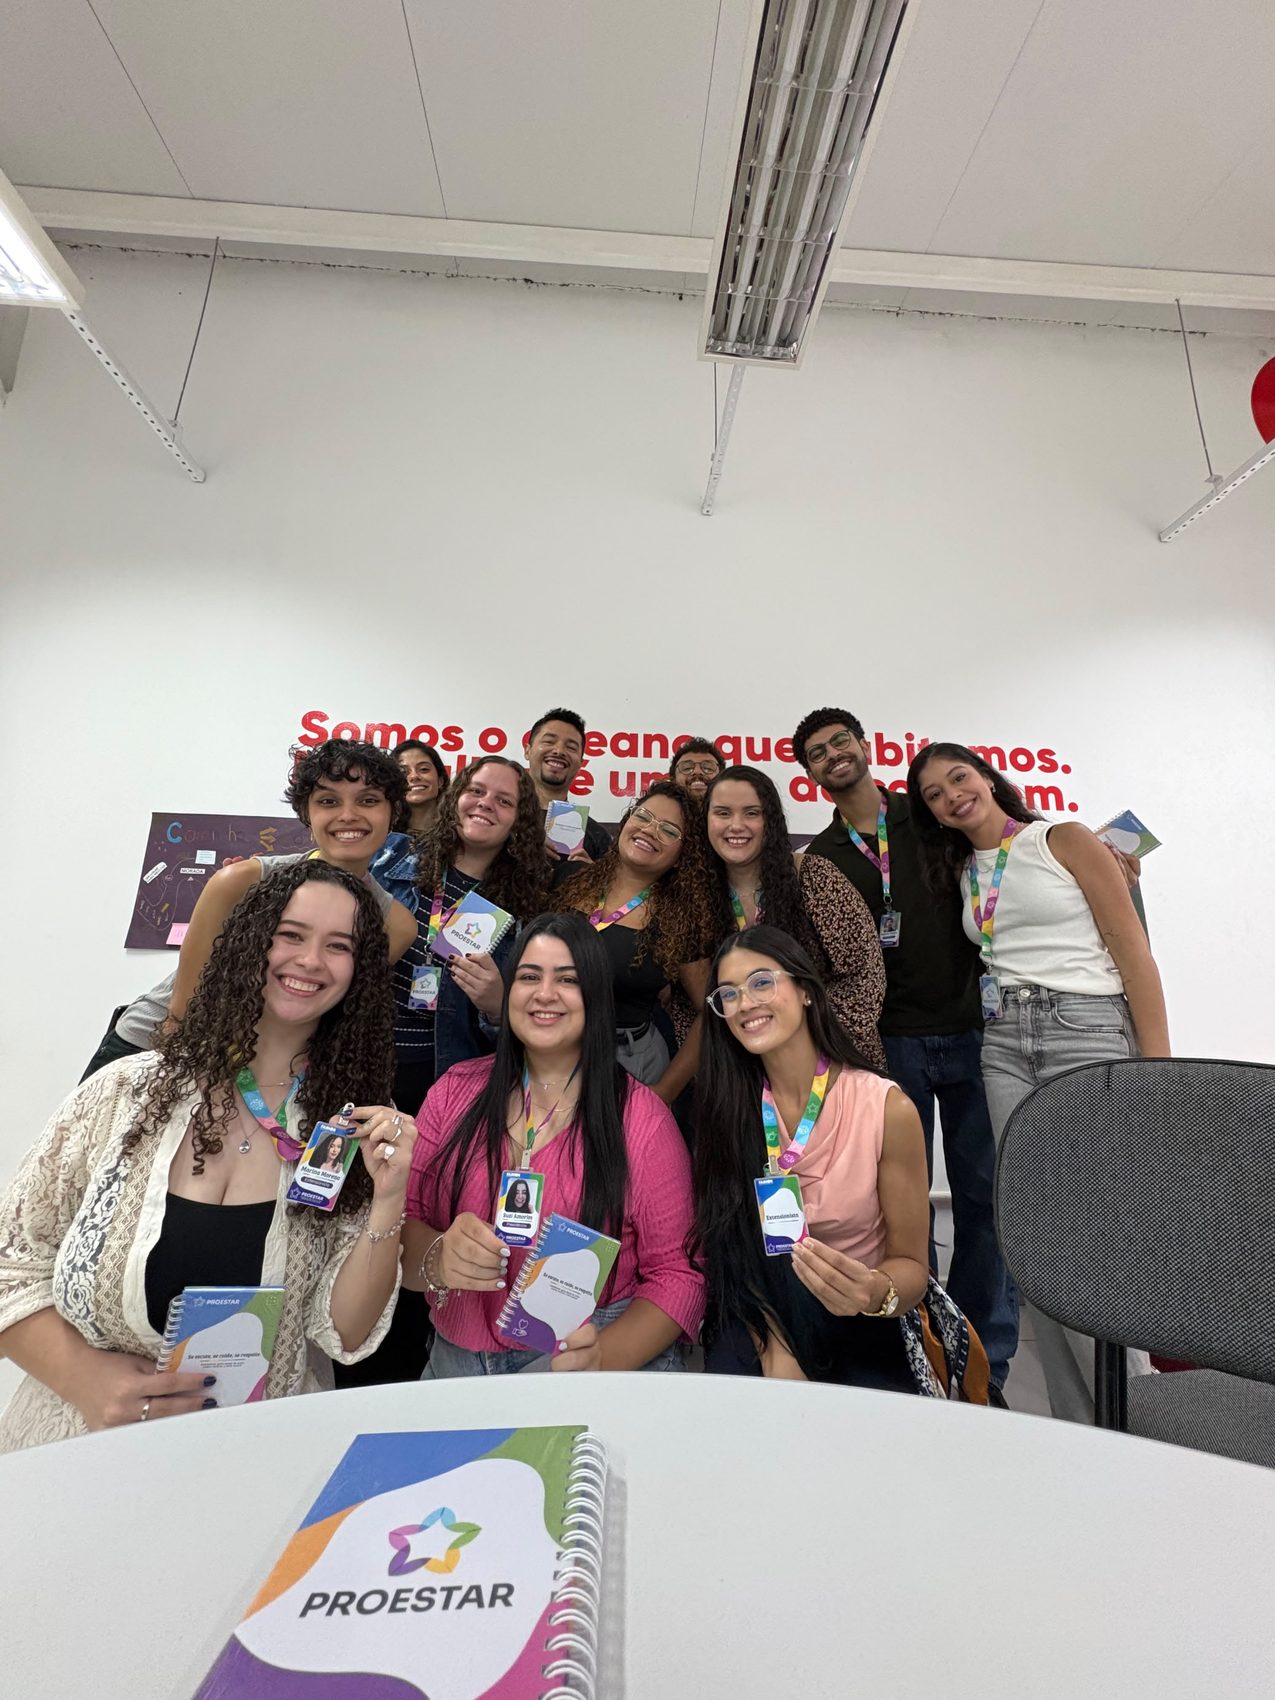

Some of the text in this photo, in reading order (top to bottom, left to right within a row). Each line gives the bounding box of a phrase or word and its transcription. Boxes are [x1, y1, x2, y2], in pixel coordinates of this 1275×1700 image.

[298, 710, 464, 752] Somos
[478, 727, 508, 754] o
[713, 734, 798, 766] que
[568, 759, 595, 797] é
[450, 929, 481, 951] PROESTAR
[566, 1227, 590, 1241] PROESTAR
[299, 1582, 516, 1618] PROESTAR
